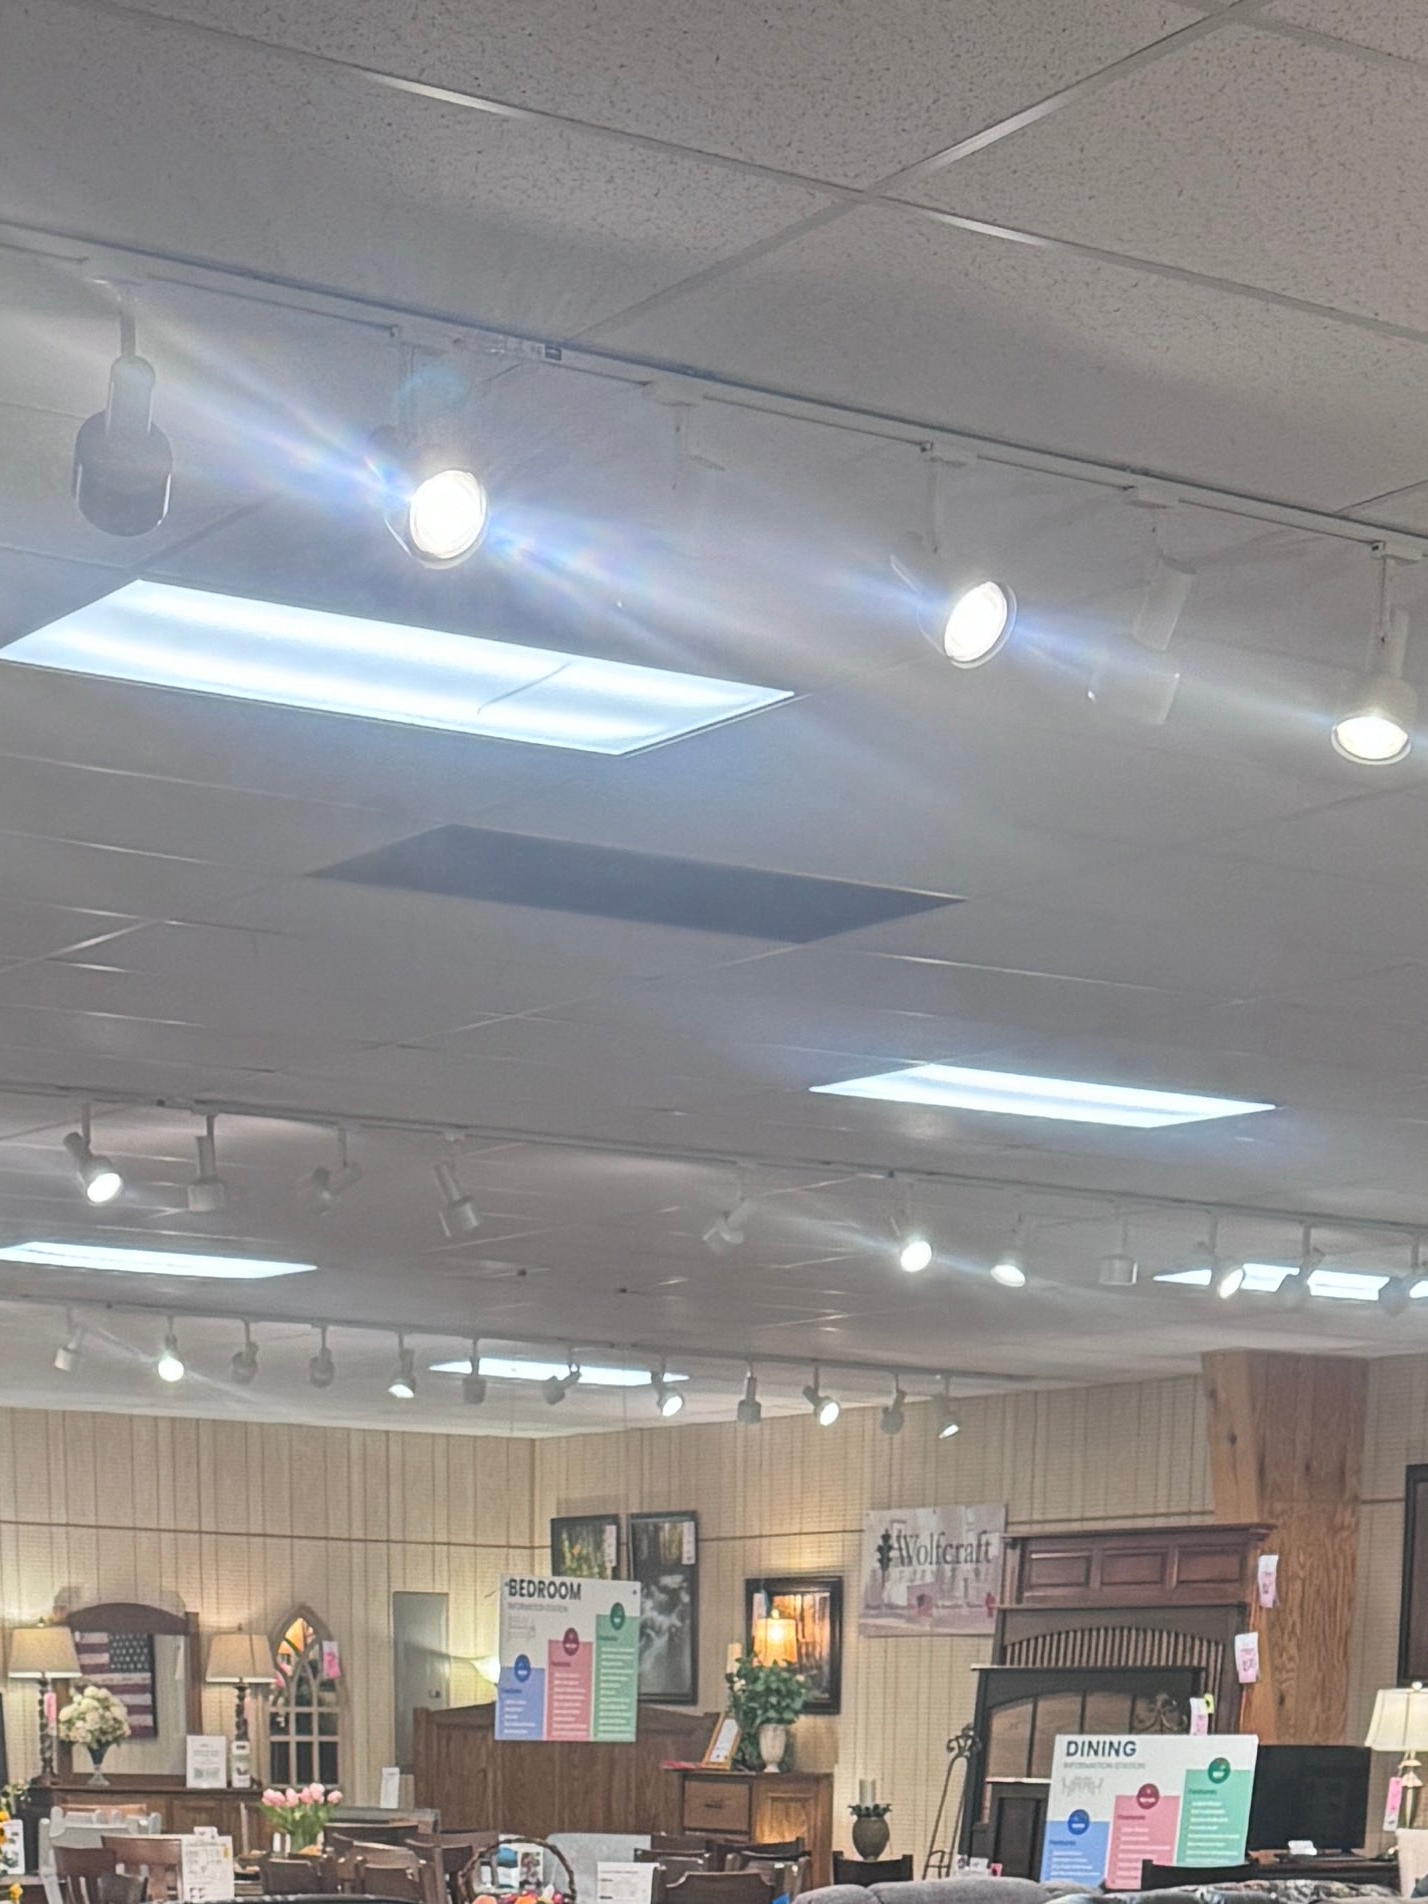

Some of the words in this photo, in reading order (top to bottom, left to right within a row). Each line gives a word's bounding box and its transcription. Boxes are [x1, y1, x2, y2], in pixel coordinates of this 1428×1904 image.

[895, 1529, 991, 1567] Wolfcraft
[508, 1578, 581, 1600] BEDROOM
[1065, 1740, 1137, 1757] DINING
